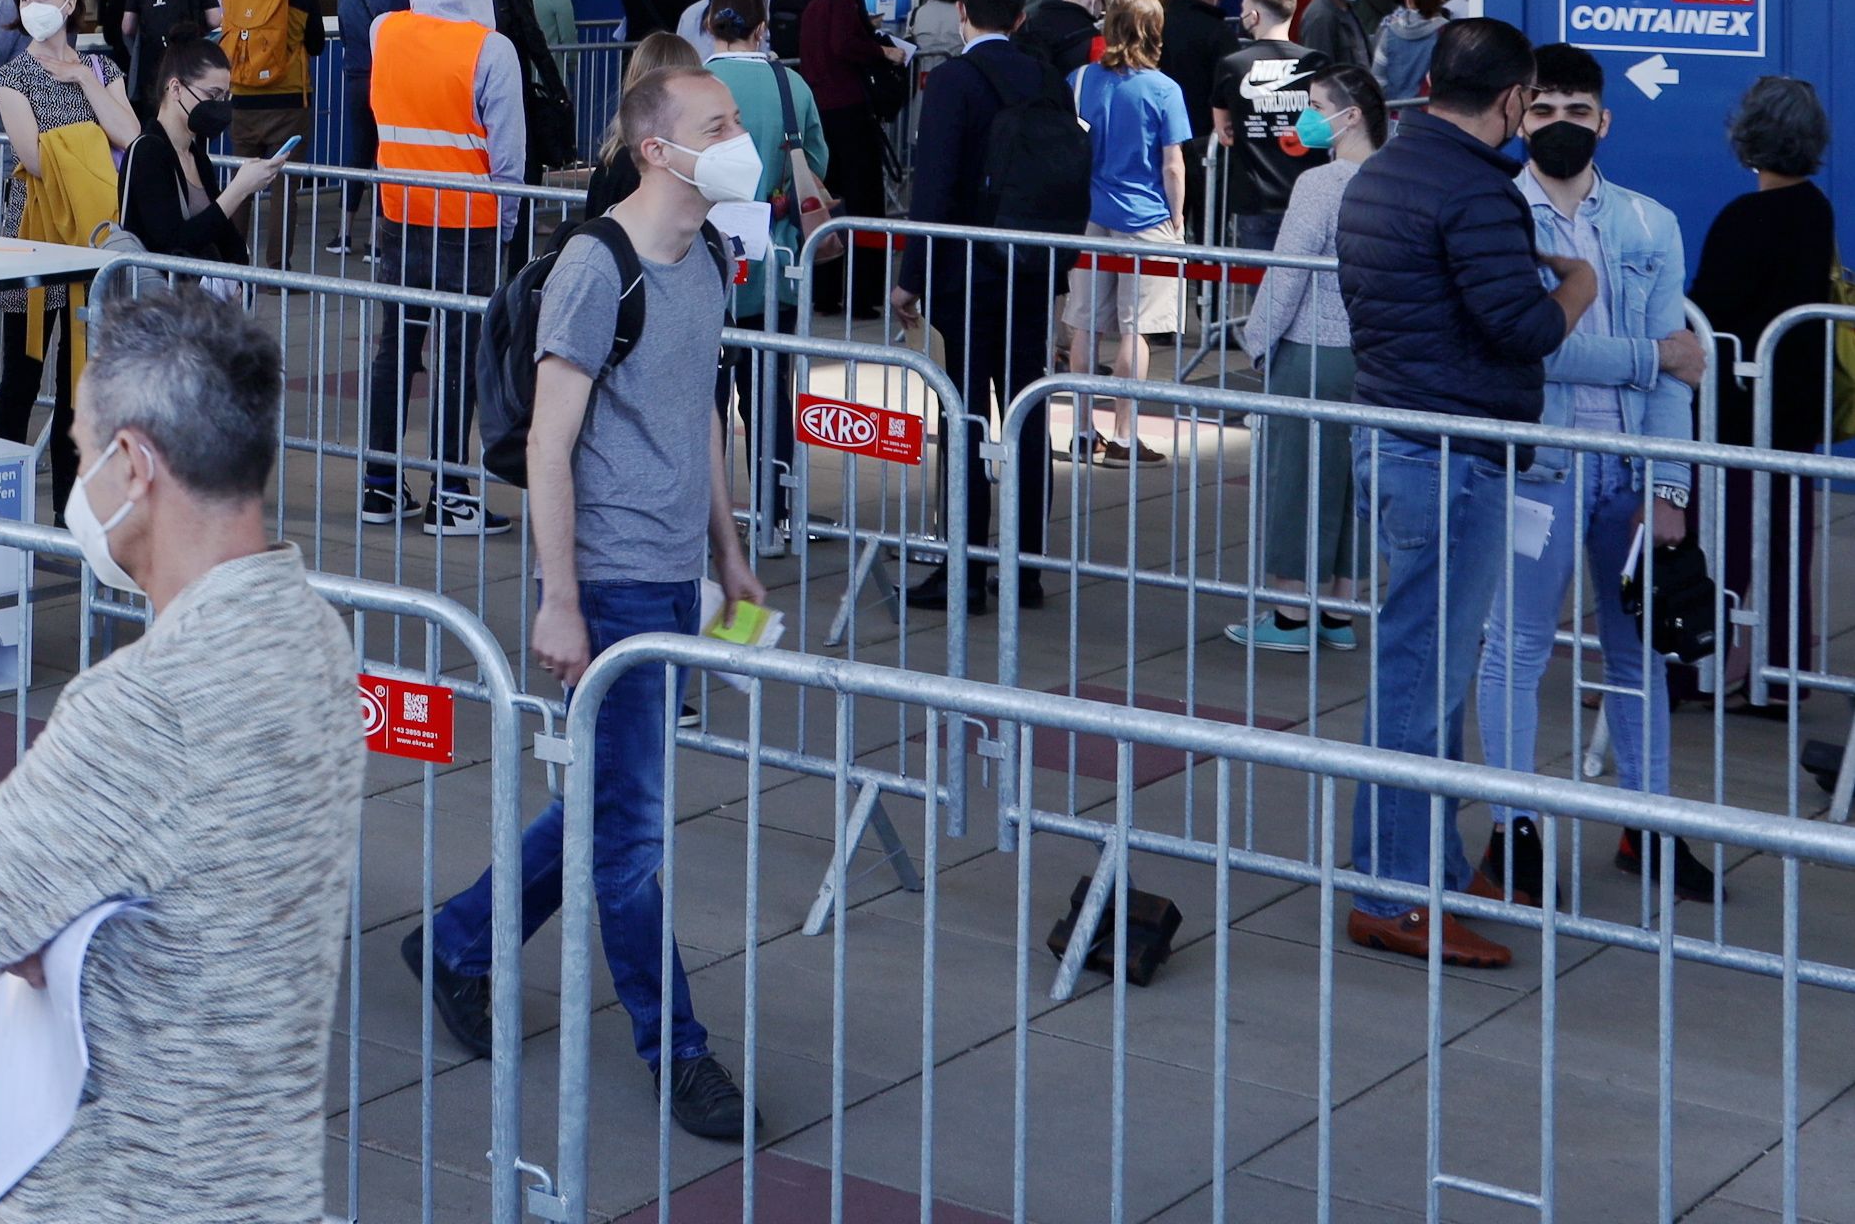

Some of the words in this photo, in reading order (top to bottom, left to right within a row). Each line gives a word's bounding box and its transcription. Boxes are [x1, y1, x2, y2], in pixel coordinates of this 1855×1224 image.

[1570, 5, 1754, 37] CONTAINEX
[1249, 59, 1300, 82] NIKE
[804, 407, 871, 443] EKRO
[396, 737, 435, 749] www.ekro.at
